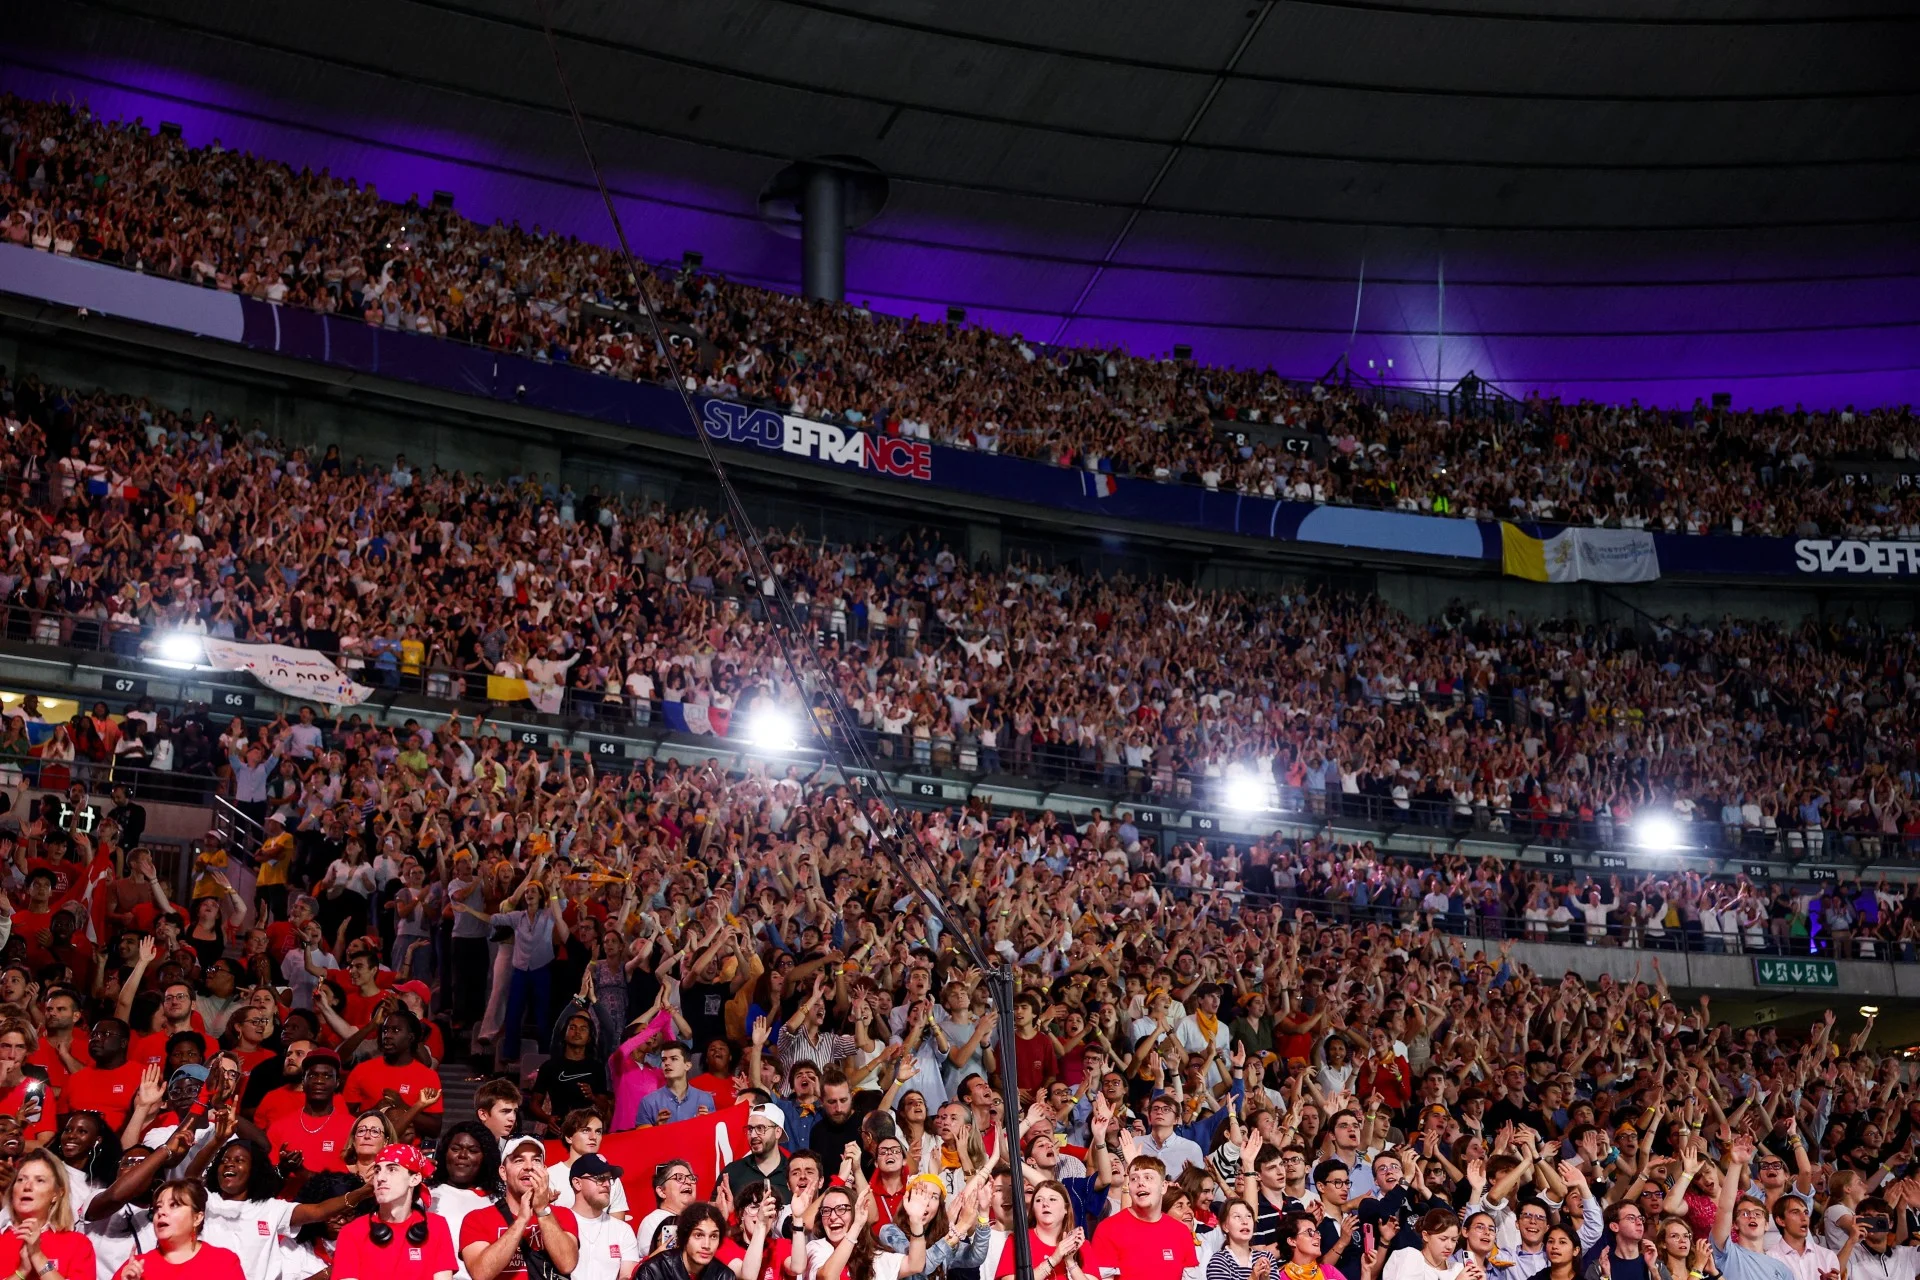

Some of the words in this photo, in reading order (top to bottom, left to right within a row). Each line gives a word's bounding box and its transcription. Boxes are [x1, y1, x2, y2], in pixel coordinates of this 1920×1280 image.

[115, 679, 134, 691] 67
[225, 693, 243, 705] 66
[522, 733, 537, 744] 65
[600, 743, 615, 754] 64
[920, 784, 934, 795] 62
[1142, 812, 1153, 822] 61
[1200, 819, 1212, 829] 60
[1553, 854, 1565, 863] 59
